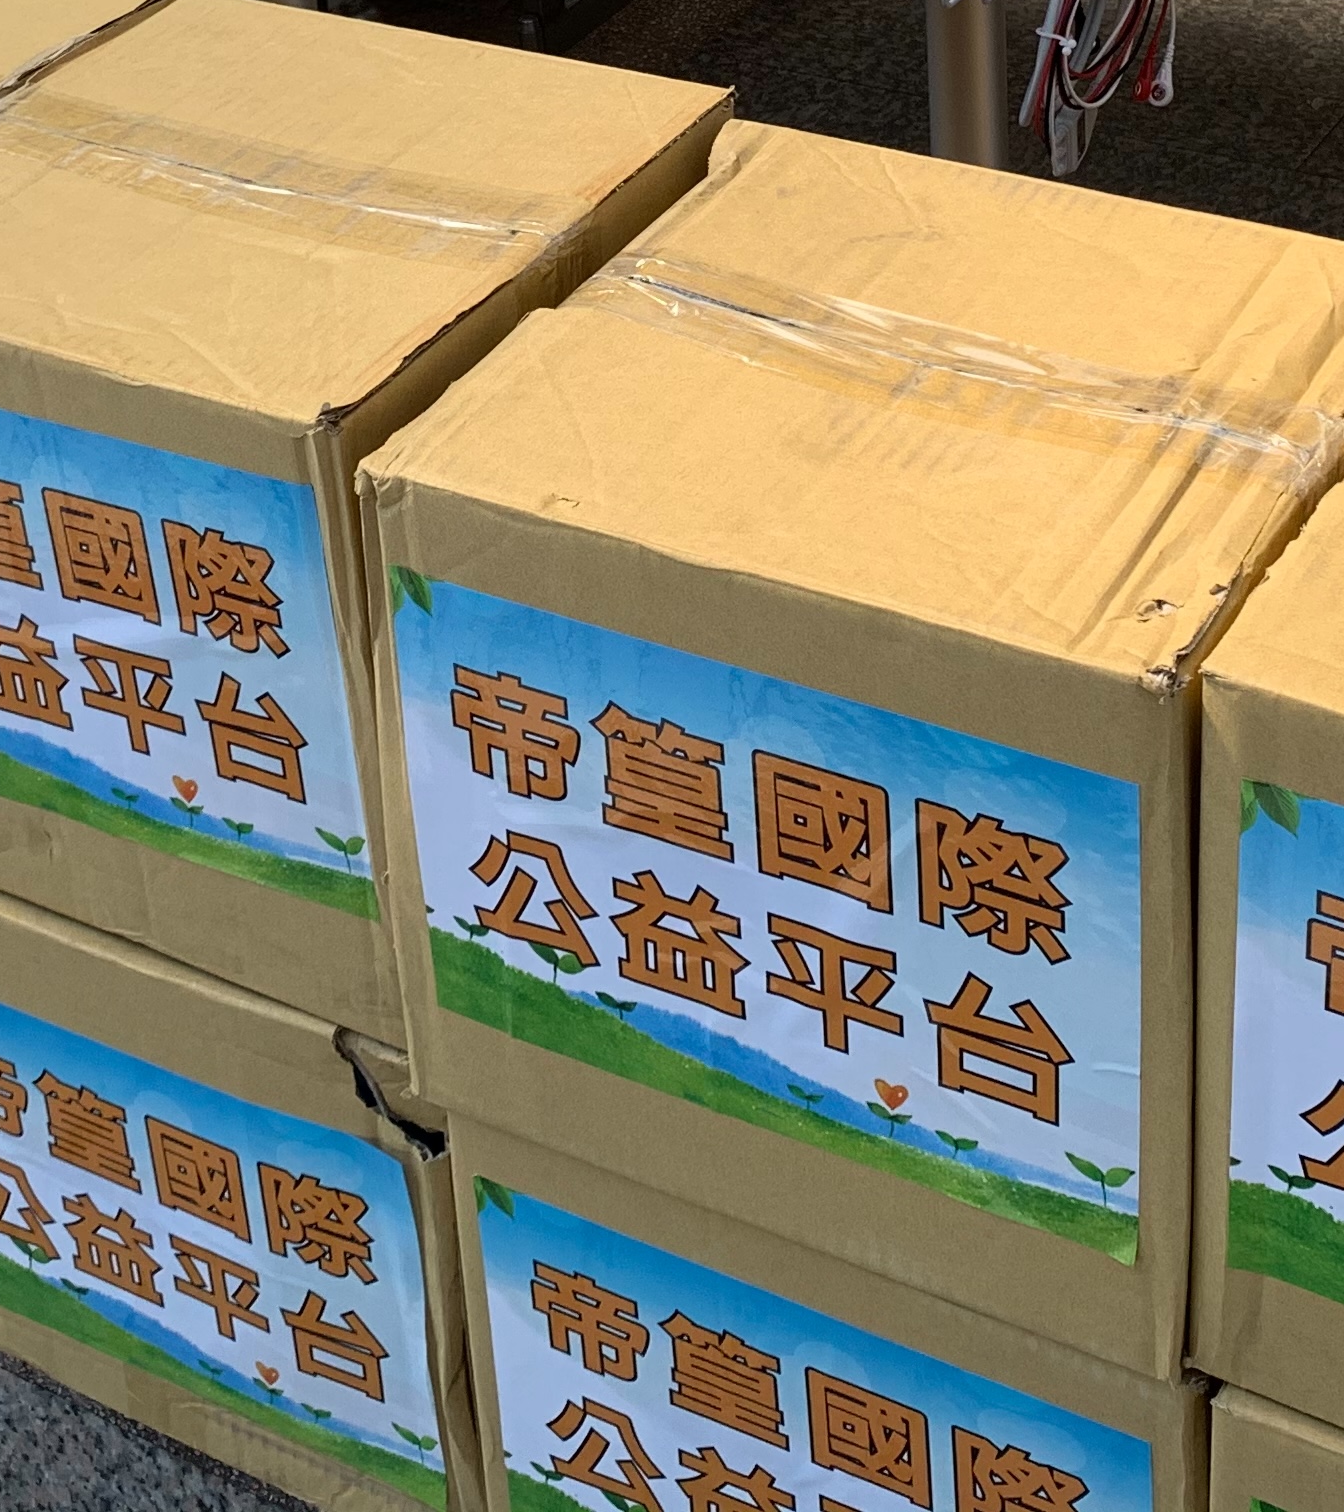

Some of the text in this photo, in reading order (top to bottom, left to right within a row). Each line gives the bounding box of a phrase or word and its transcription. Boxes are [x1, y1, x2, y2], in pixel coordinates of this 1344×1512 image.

[451, 662, 1072, 965] 帝篁國際
[467, 826, 1076, 1127] 公益平台
[530, 1257, 1091, 1512] 帝篁國際
